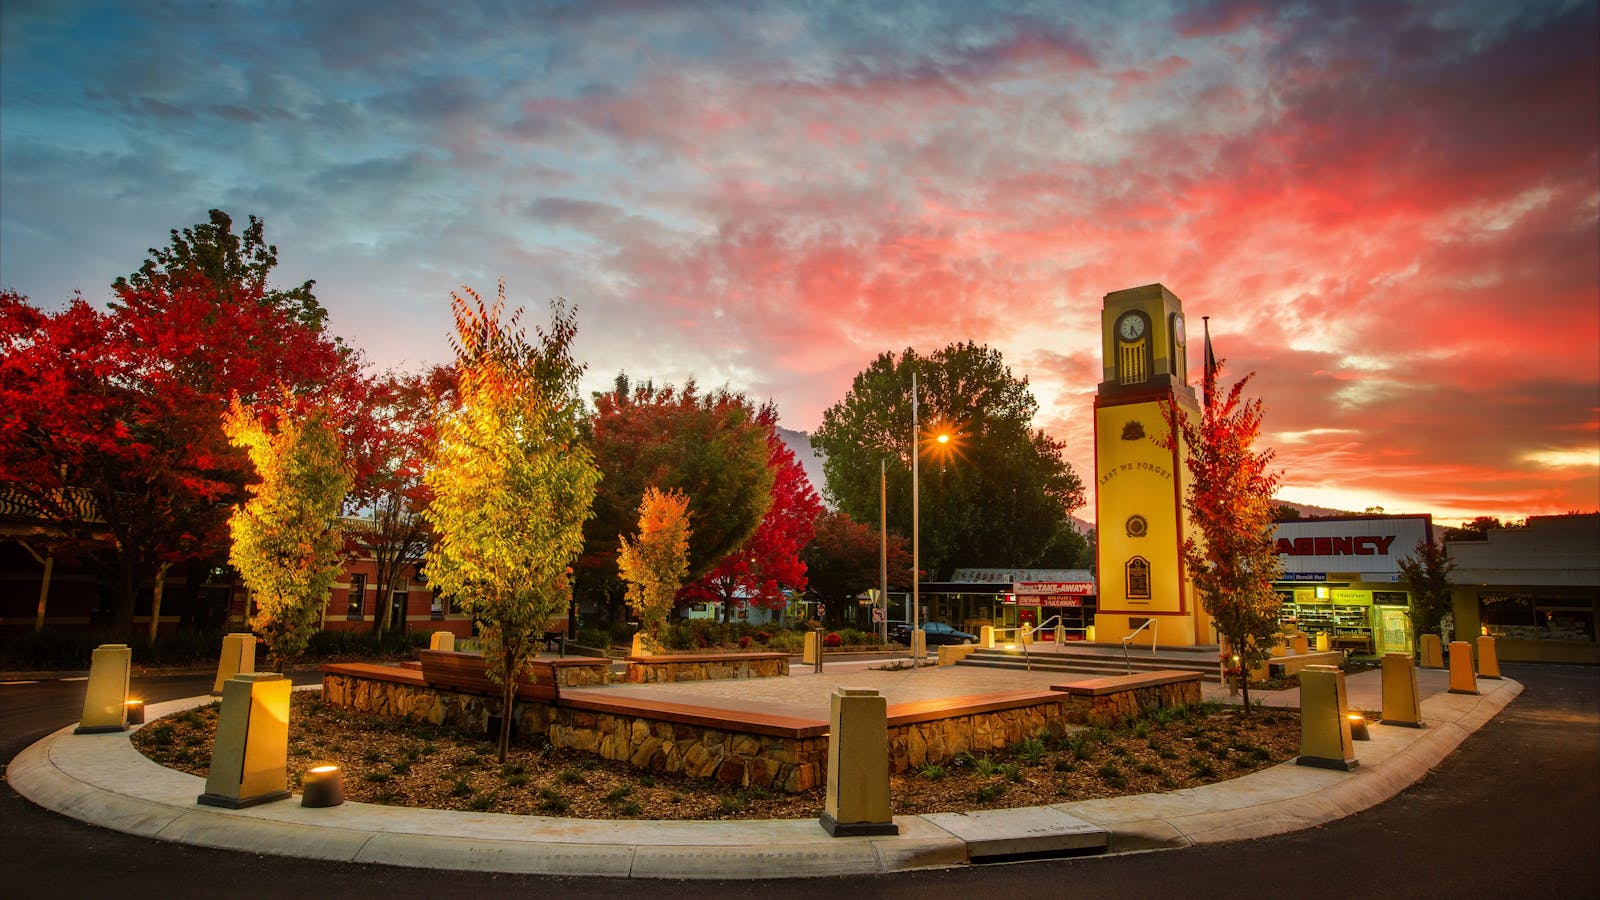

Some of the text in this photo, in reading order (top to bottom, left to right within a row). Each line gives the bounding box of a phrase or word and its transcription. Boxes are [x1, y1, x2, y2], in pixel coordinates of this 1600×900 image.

[1099, 462, 1172, 485] LEST WE FORGET
[1271, 535, 1396, 556] AGENCY
[1295, 572, 1313, 580] Herald
[1037, 583, 1084, 593] TAKE-AWAY
[1336, 628, 1371, 637] Herald Sun
